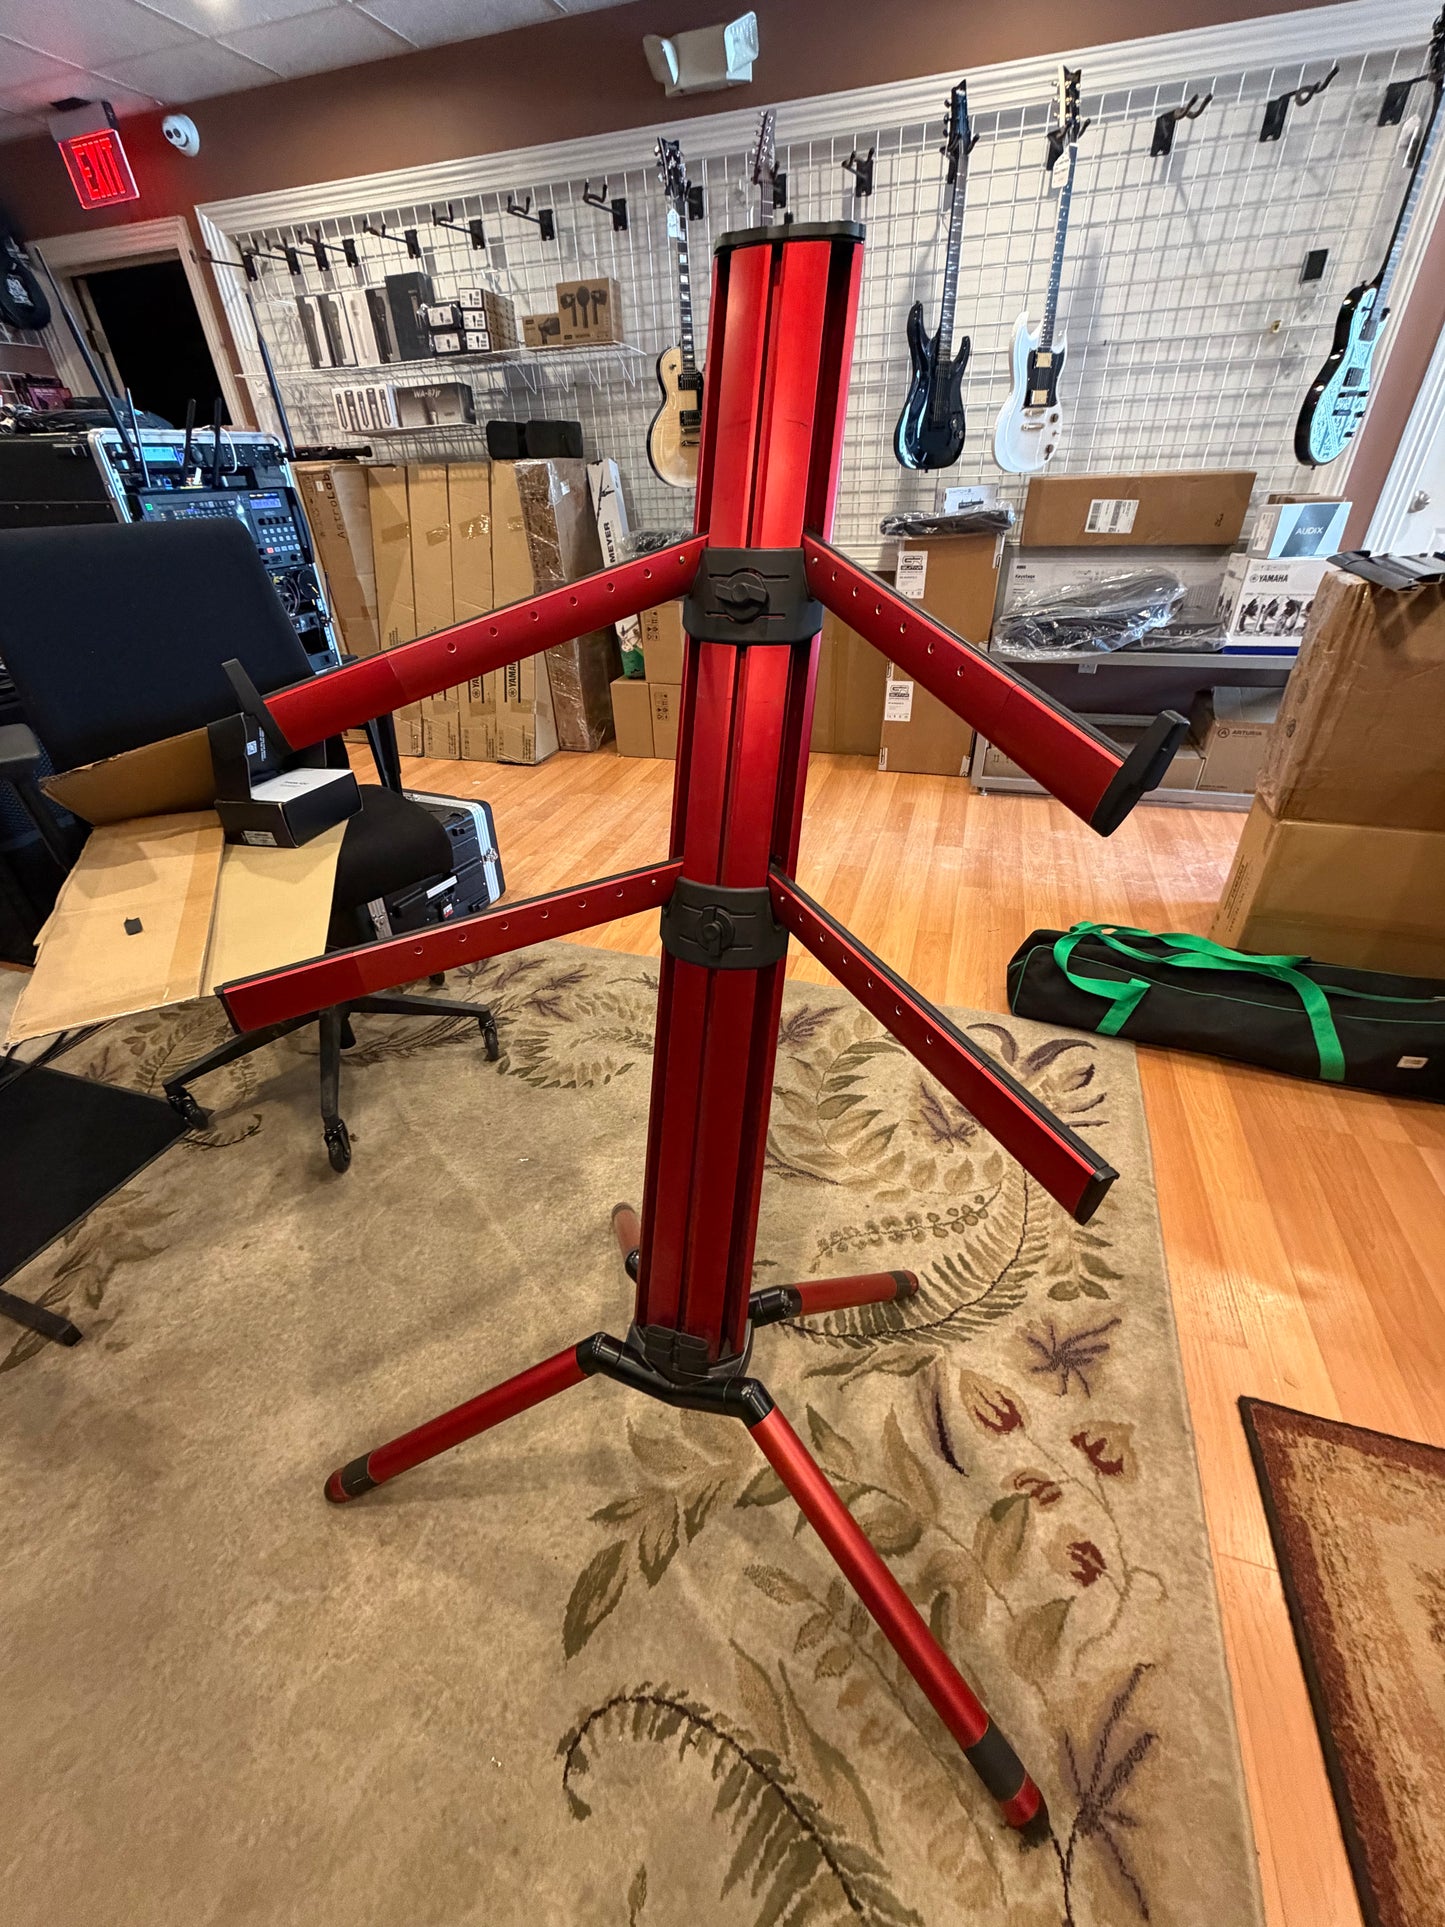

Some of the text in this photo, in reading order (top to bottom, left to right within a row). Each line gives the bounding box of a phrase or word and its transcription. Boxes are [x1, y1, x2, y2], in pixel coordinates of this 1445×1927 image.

[71, 137, 126, 200] EXIT
[1295, 526, 1324, 536] AUDIX
[1259, 574, 1288, 583] YAMAHA
[508, 662, 517, 688] YAMA
